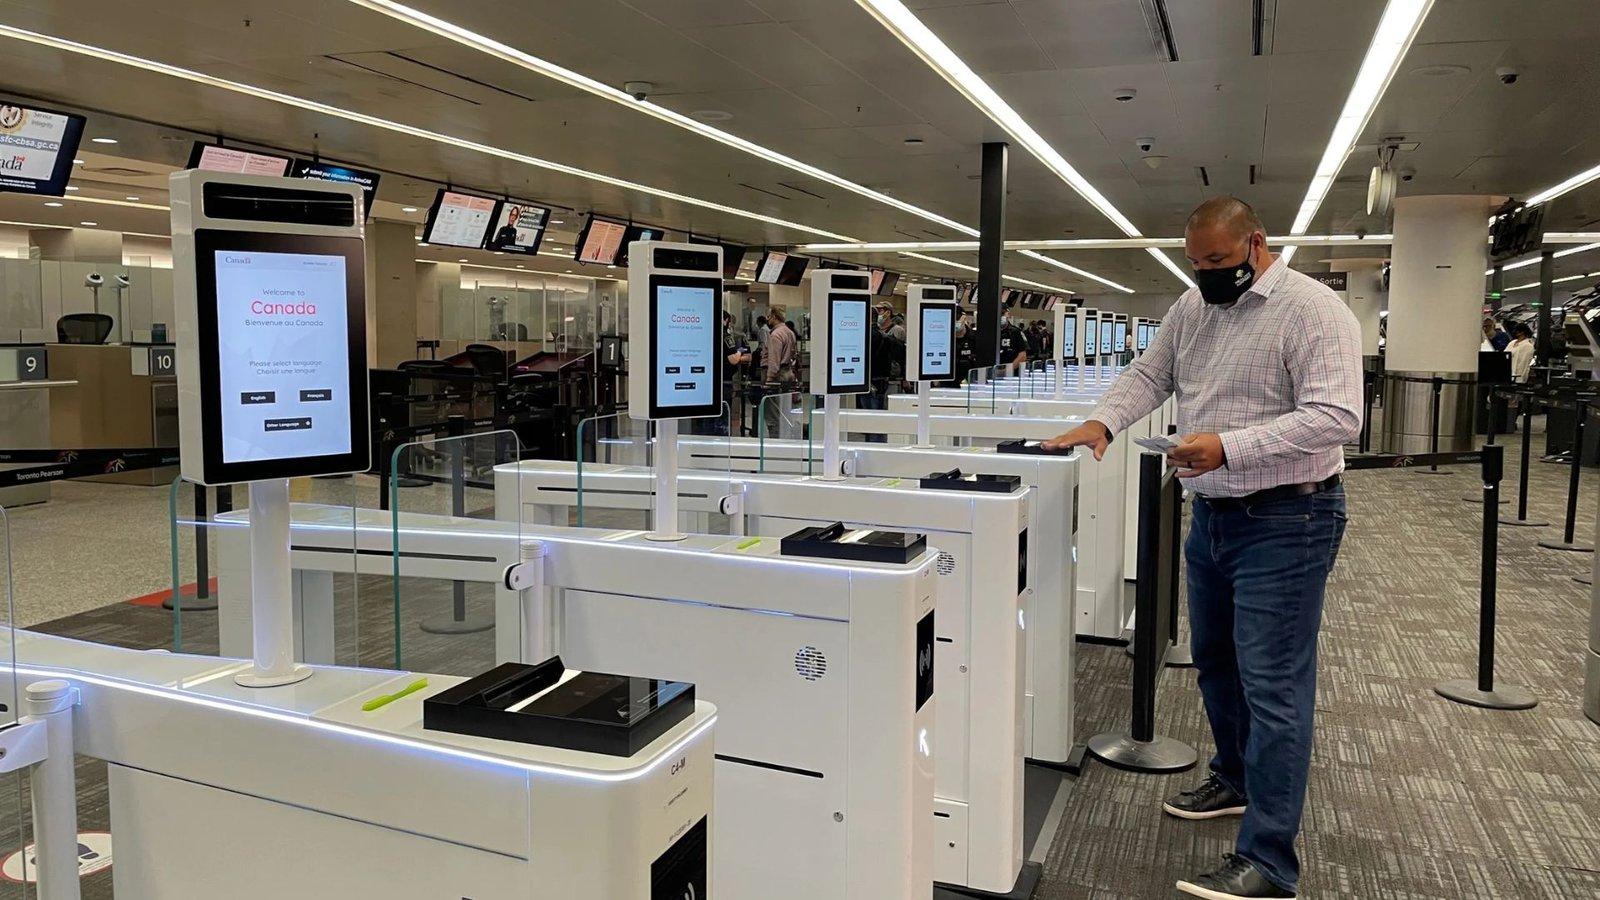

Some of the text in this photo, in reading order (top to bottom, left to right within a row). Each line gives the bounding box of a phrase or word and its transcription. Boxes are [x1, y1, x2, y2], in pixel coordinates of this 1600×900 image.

[1319, 277, 1344, 285] Sortie
[263, 288, 295, 296] Welcome
[251, 300, 316, 315] Canada
[245, 319, 283, 327] Bienvenue
[295, 319, 324, 327] Canada
[671, 313, 700, 323] Canada
[608, 343, 615, 360] 1
[25, 357, 37, 372] 9
[156, 355, 172, 369] 10
[40, 469, 64, 477] Pearson
